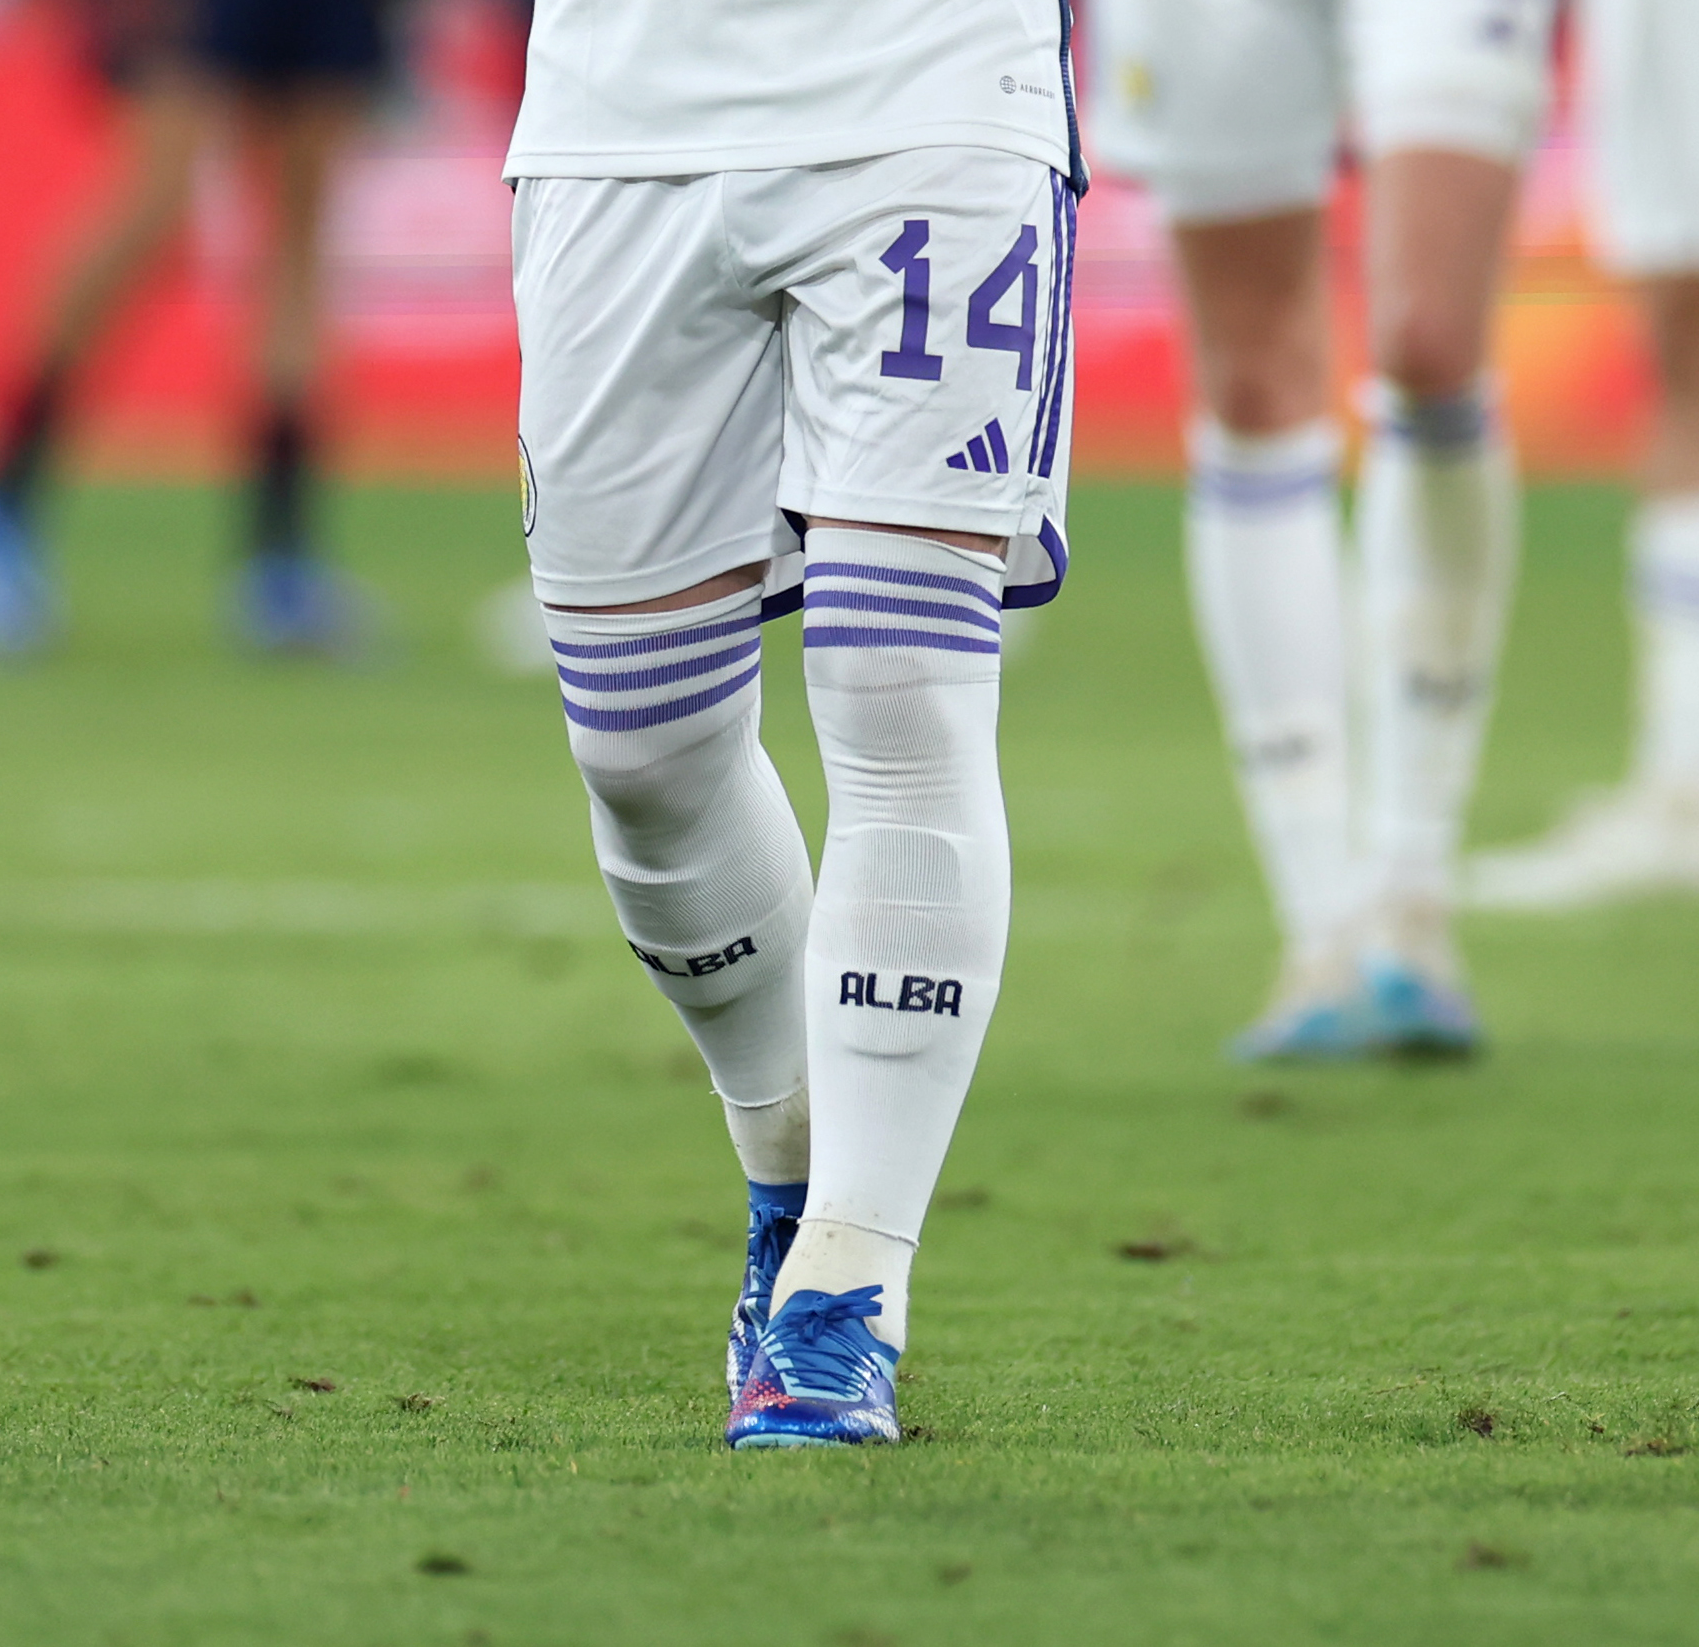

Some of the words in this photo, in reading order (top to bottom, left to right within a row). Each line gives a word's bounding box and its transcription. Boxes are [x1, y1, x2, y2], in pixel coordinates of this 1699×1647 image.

[879, 218, 1040, 392] 14
[627, 936, 758, 977] ALBA
[839, 971, 963, 1018] ALBA
